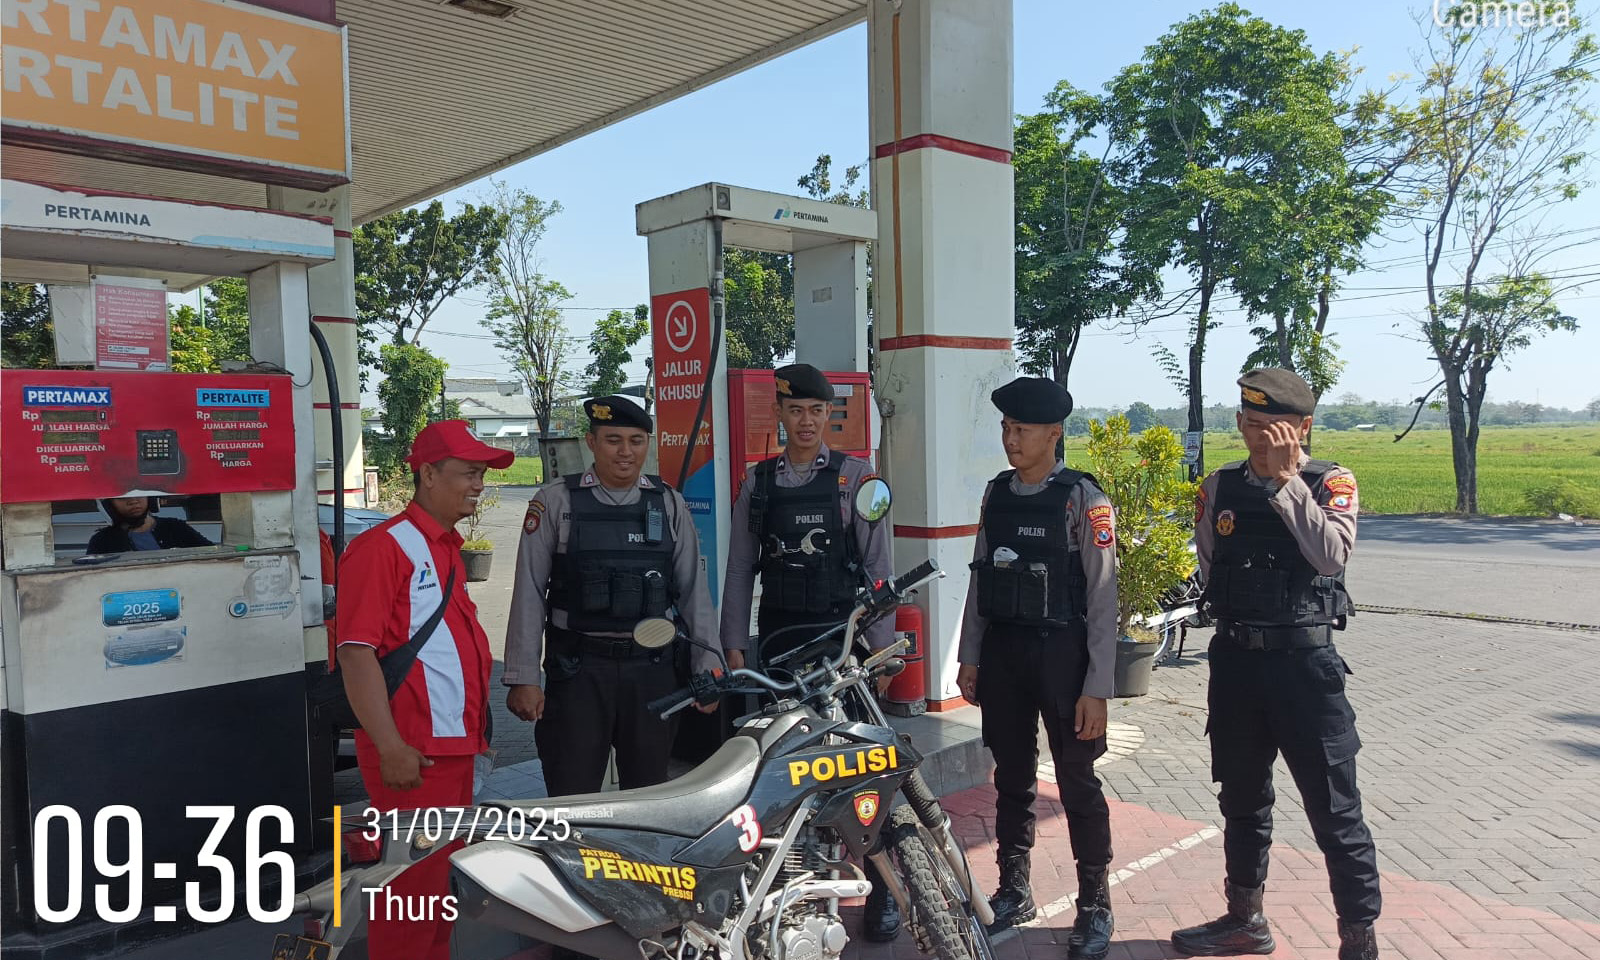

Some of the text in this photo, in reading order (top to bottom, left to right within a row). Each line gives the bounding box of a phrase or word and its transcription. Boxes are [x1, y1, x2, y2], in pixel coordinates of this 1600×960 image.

[1, 44, 300, 140] RTALITE
[45, 204, 151, 226] PERTAMINA
[793, 211, 829, 224] PERTAMINA
[662, 360, 702, 377] JALUR
[28, 390, 109, 404] PERTAMAX
[202, 393, 265, 404] PERTALITE
[22, 410, 39, 421] Rp
[196, 411, 211, 421] Rp
[75, 423, 110, 431] HARGA
[203, 422, 237, 430] JUMLAH
[661, 431, 710, 447] PERTAAX
[36, 444, 106, 453] DIKELUARKAN
[206, 442, 264, 450] DIKELUARKAN
[40, 455, 57, 465] Rp
[210, 450, 225, 460] Rp
[54, 465, 90, 473] HARGA
[222, 460, 252, 468] HARGA
[795, 514, 824, 524] POLISI
[1017, 526, 1046, 537] POLISI
[123, 602, 160, 616] 2025
[788, 745, 898, 786] POLISI
[565, 808, 613, 819] awasaki
[731, 804, 764, 853] 3
[578, 848, 622, 859] PATROLI
[582, 856, 697, 890] PERINTIS
[663, 886, 694, 900] PRESISI
